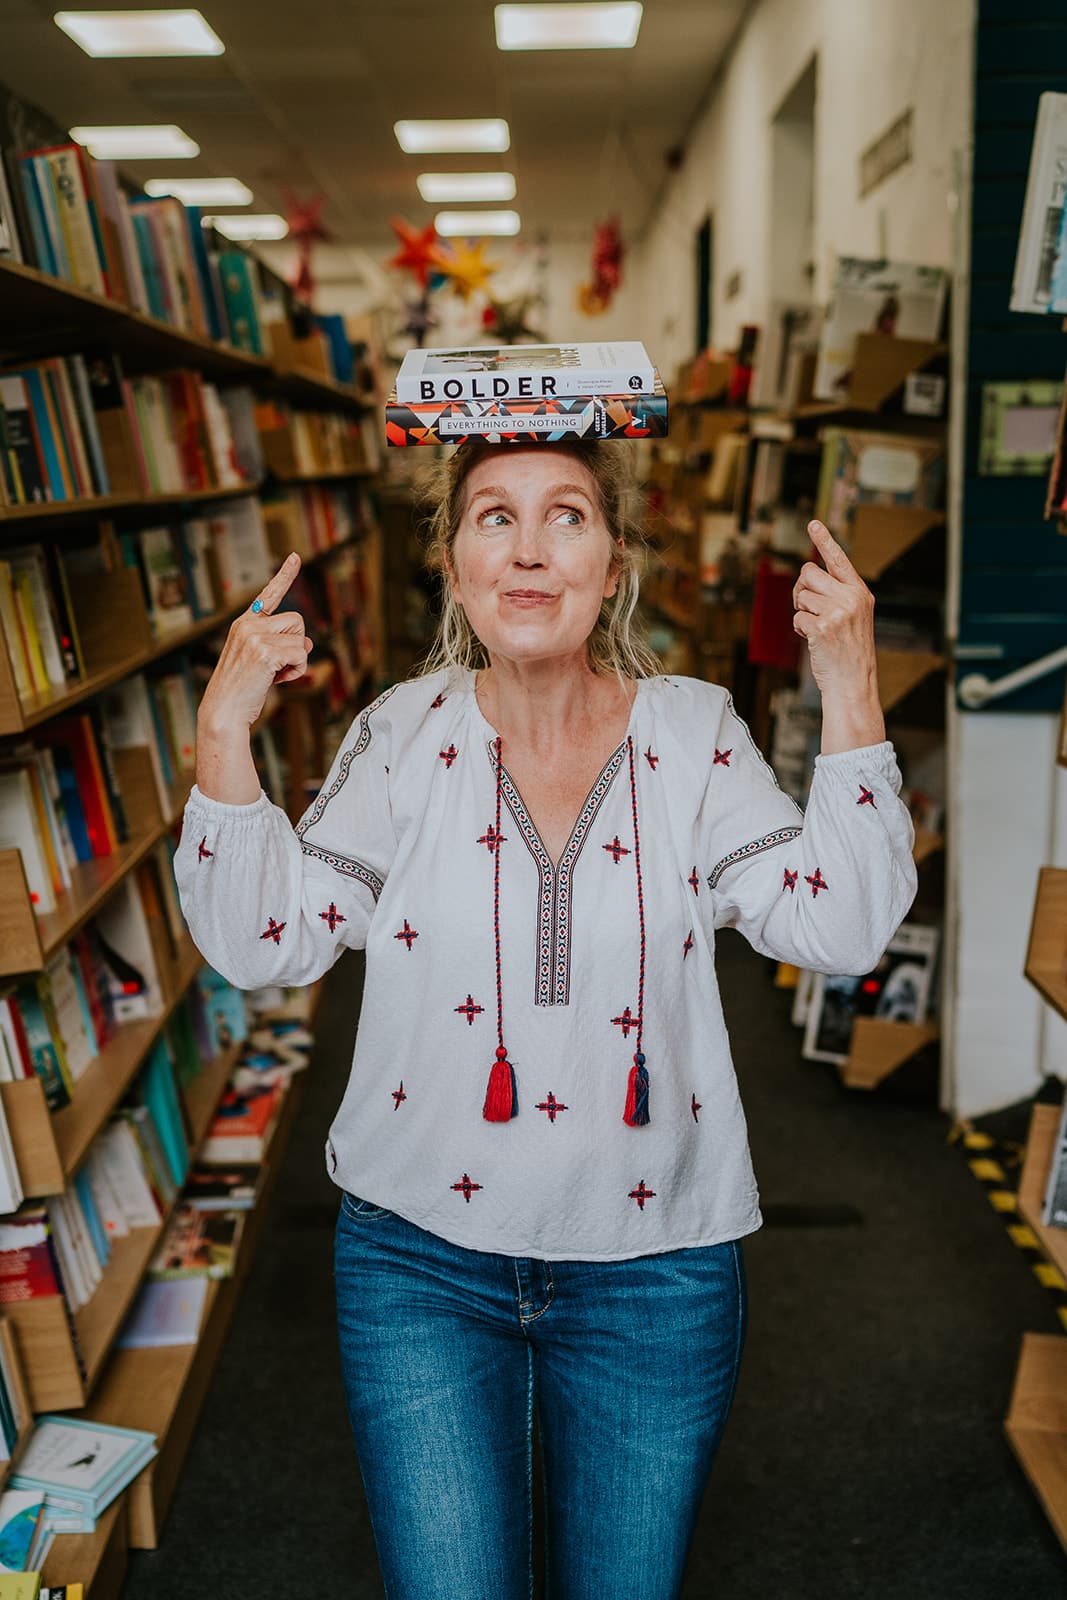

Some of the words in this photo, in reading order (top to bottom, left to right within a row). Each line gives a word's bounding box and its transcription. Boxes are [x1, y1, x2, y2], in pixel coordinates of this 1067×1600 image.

[420, 376, 557, 400] BOLDER
[447, 420, 508, 430] EVERYTHING
[511, 420, 525, 428] TO
[529, 418, 576, 427] NOTHING
